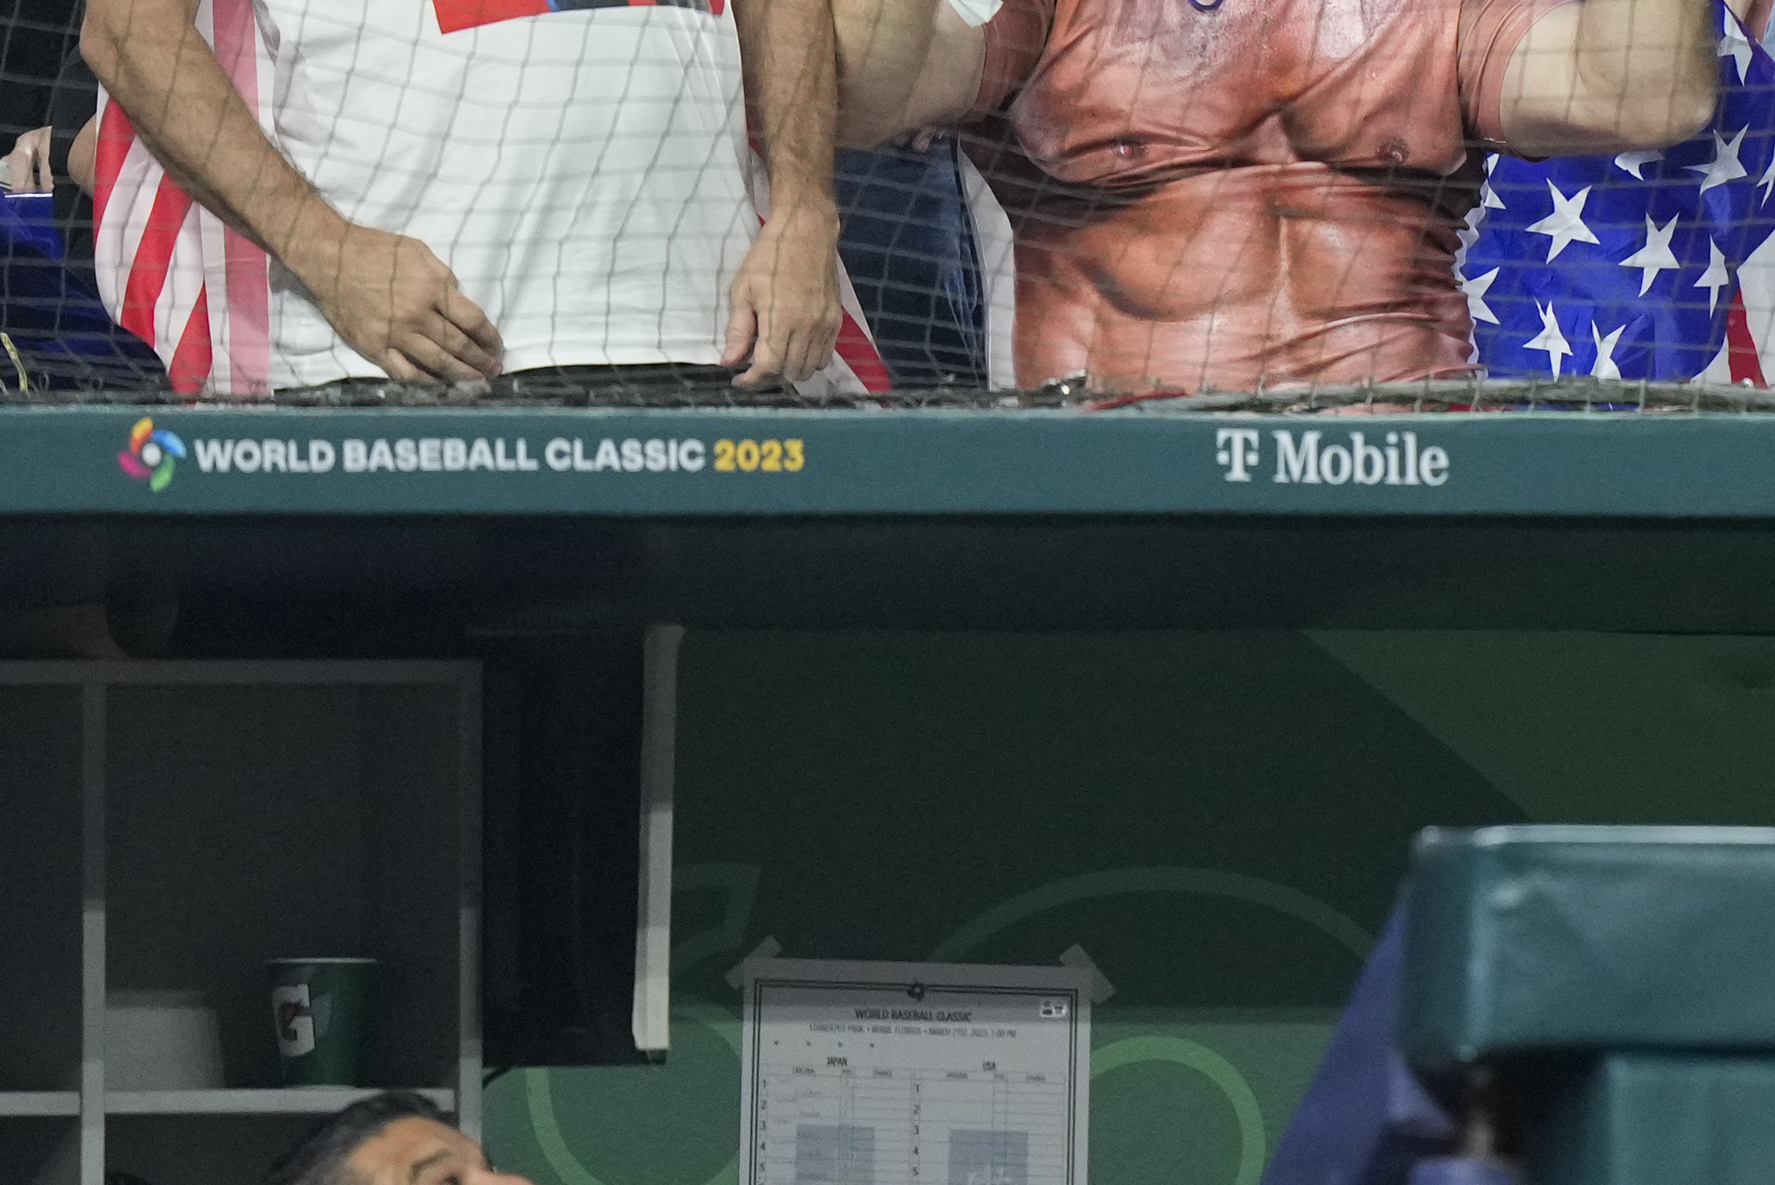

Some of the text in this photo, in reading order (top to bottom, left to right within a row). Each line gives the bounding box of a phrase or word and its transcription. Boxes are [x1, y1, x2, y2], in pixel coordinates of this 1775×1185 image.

[193, 437, 805, 473] WORLD BASEBALL CLASSIC 2023
[1216, 427, 1450, 487] T Mobile
[272, 983, 316, 1057] G
[855, 1008, 973, 1023] WORLD BASEBALL CLASSIC
[826, 1056, 848, 1067] JAPAN
